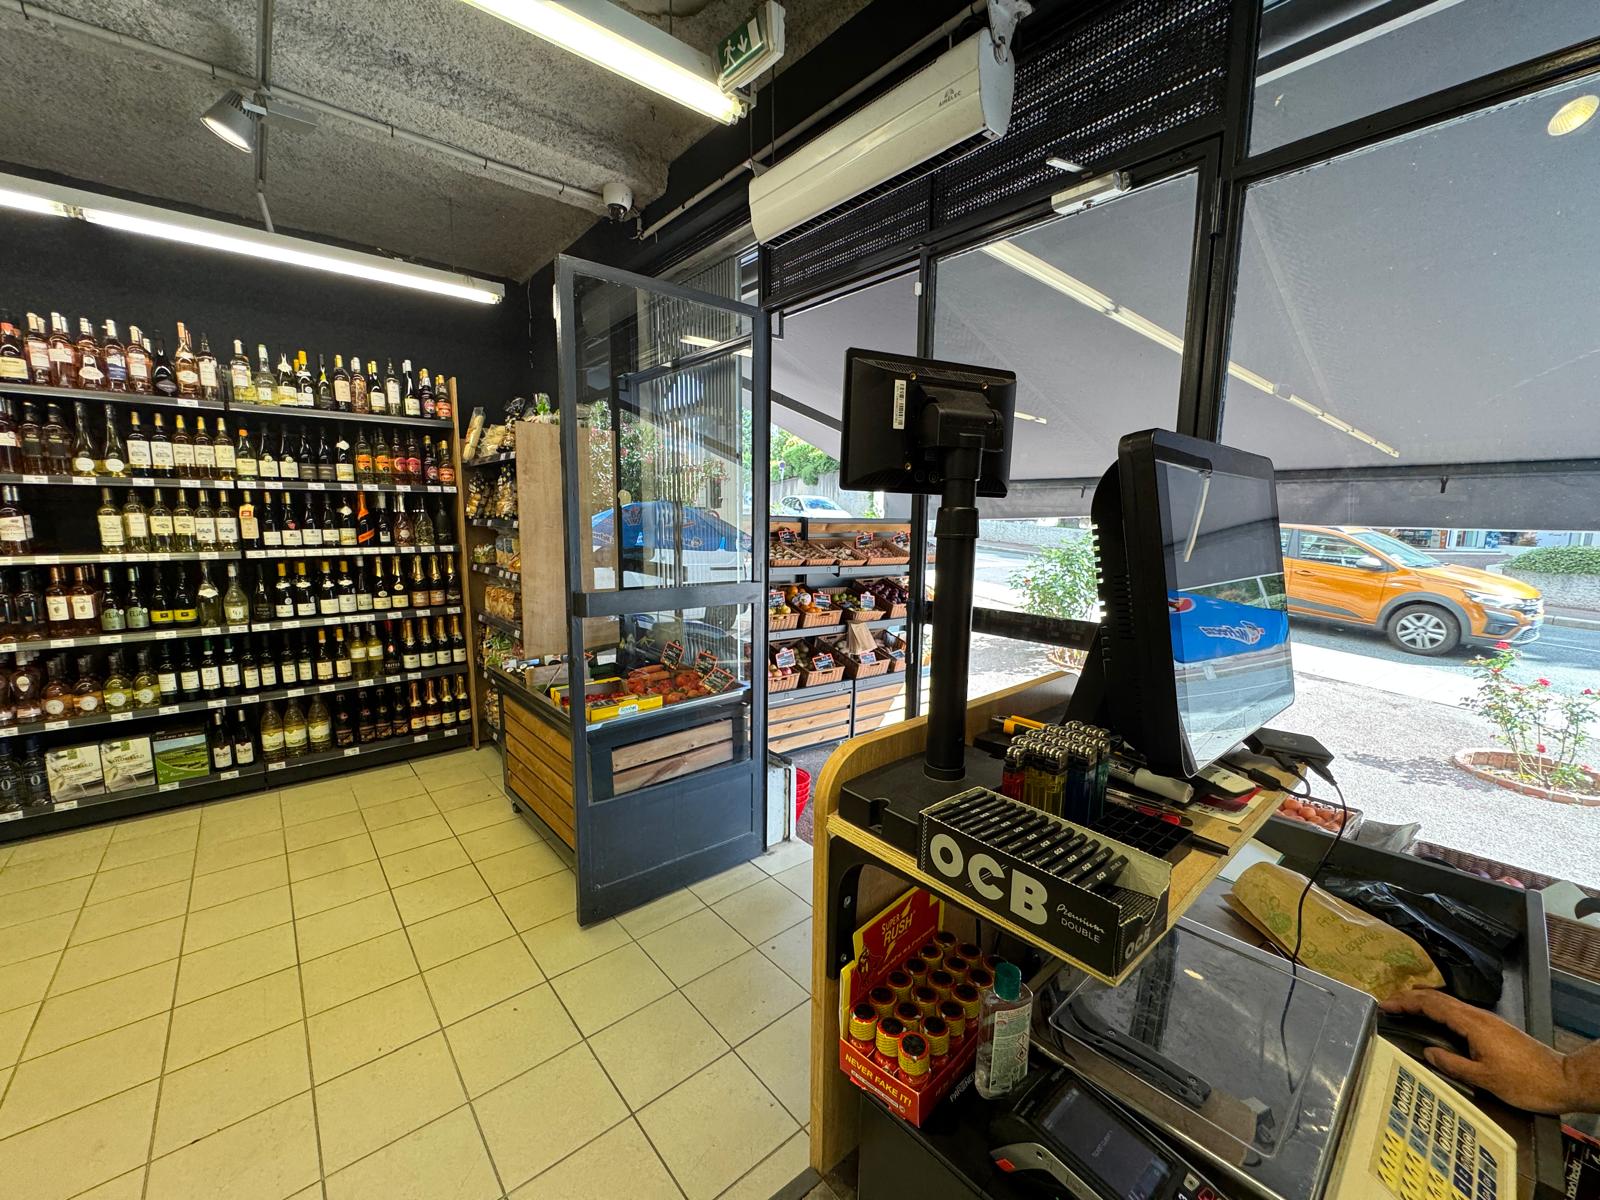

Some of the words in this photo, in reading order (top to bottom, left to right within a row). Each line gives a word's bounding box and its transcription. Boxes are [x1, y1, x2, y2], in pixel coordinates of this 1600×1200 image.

[930, 833, 1048, 925] OCB
[881, 913, 900, 935] SUPER
[884, 912, 913, 947] RUSH
[1056, 903, 1105, 935] Premium
[1061, 917, 1101, 944] DOUBLE
[1124, 926, 1151, 960] OCB
[845, 1053, 874, 1080] NEVER
[874, 1076, 899, 1098] FAKE
[899, 1093, 912, 1107] IT!
